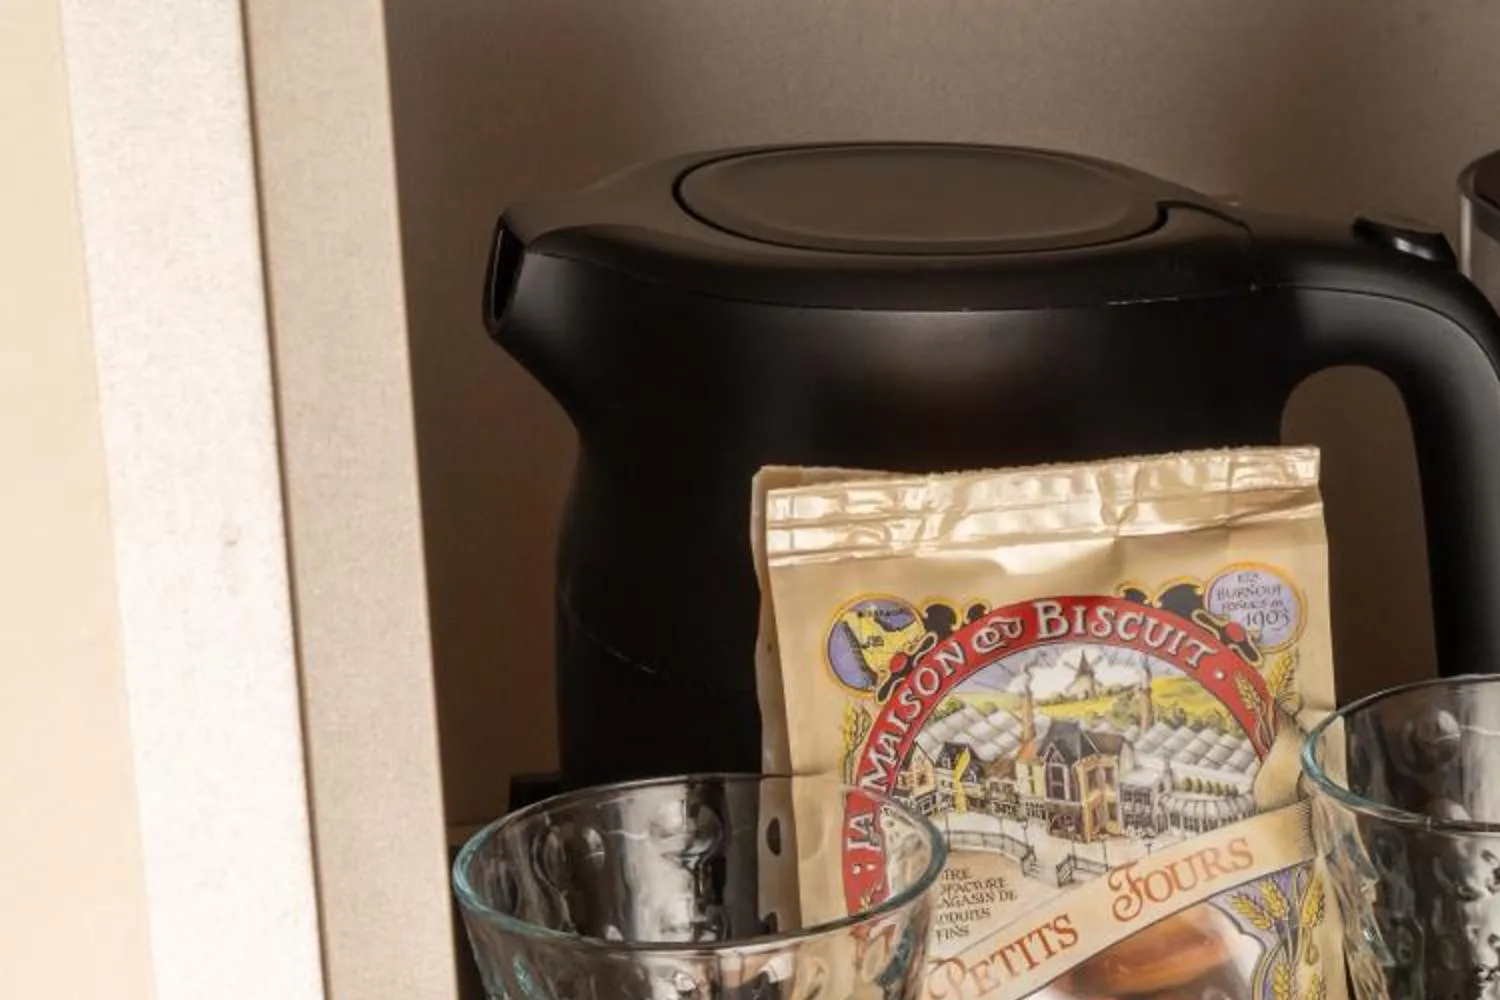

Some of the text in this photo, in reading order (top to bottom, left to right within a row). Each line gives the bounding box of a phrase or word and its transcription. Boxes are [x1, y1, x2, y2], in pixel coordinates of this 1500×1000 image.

[1246, 607, 1291, 632] 1903
[859, 640, 968, 794] MAISON
[846, 811, 882, 850] LA
[943, 868, 972, 881] TRE
[940, 891, 996, 909] AGASIN
[938, 907, 991, 923] ODUITS
